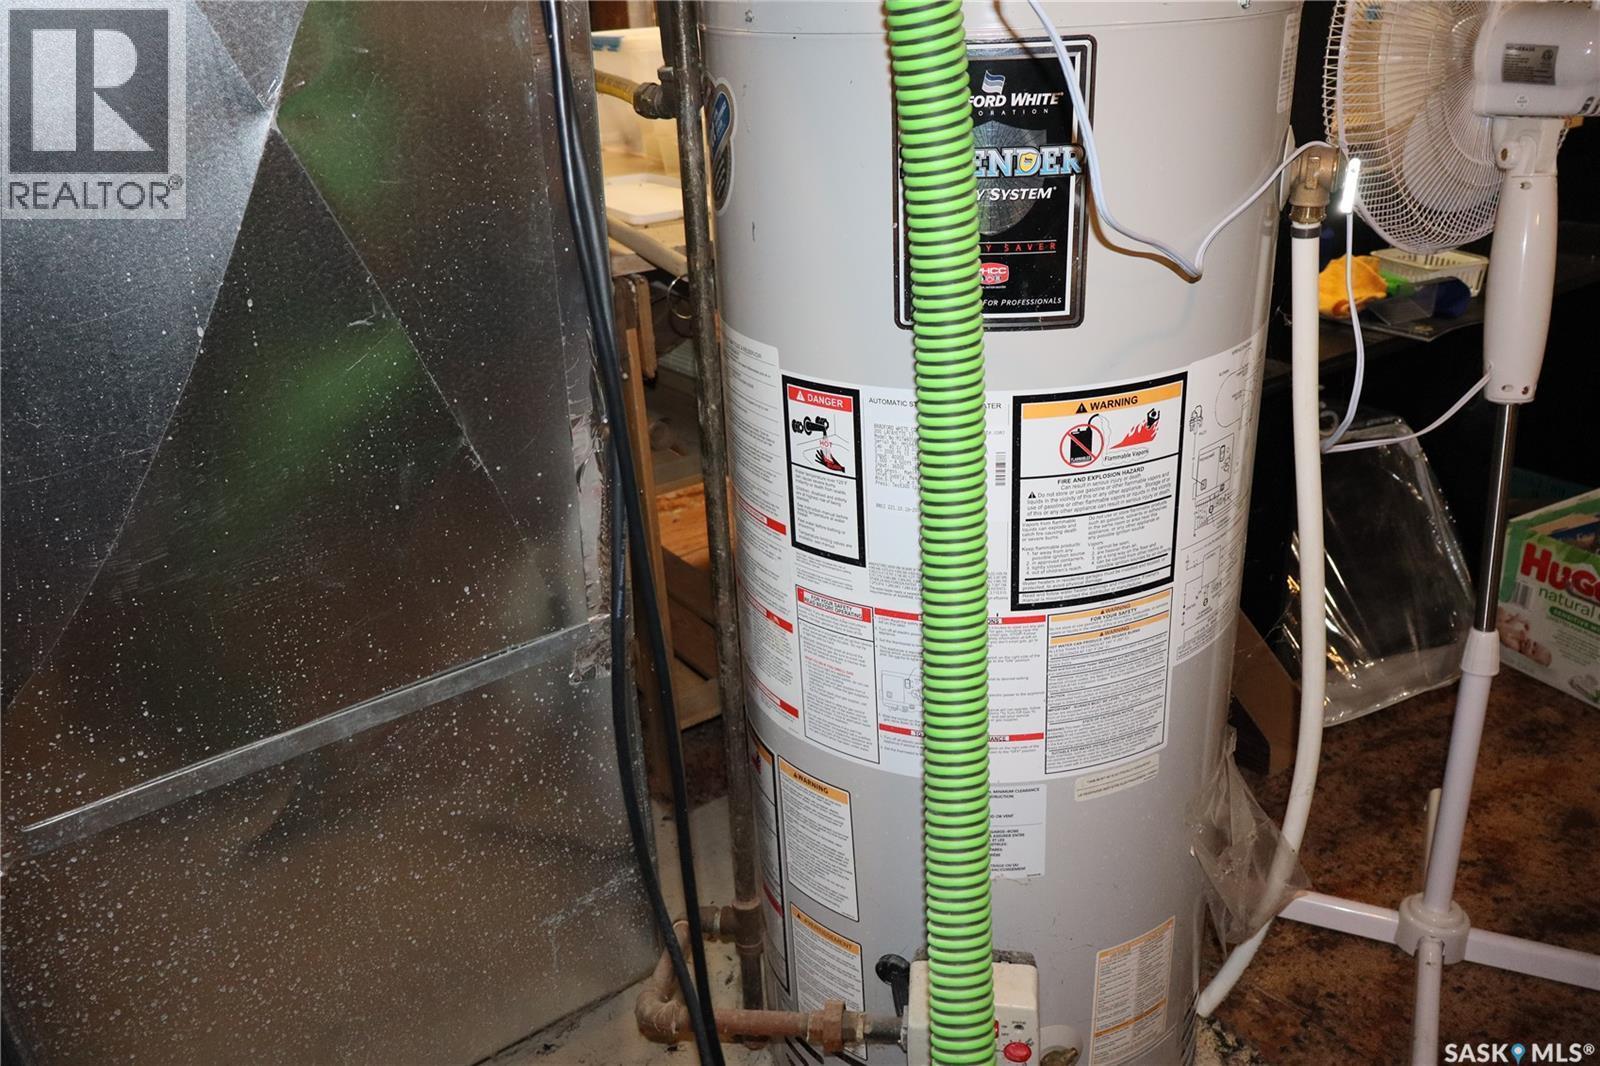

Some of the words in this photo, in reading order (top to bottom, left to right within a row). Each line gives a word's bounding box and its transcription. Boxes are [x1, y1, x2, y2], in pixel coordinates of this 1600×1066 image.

[969, 94, 1007, 108] FORD
[1011, 92, 1060, 106] WHITE
[974, 146, 1083, 178] ENDER
[990, 187, 1052, 200] SYSTEM
[1004, 242, 1056, 252] SAVER
[1001, 297, 1062, 306] PROFESSIONALS
[807, 394, 843, 408] DANGER
[869, 397, 908, 407] AUTOMATIC
[1090, 396, 1138, 410] WARNING
[1104, 452, 1132, 461] Flammable
[1132, 449, 1149, 457] Vapors
[1088, 472, 1120, 481] EXPLOSION
[1122, 466, 1144, 475] HAZARD
[1521, 542, 1600, 602] HUG
[817, 601, 834, 610] BEFORE
[834, 601, 852, 611] SAFETY
[1105, 604, 1130, 613] WARNING
[1539, 587, 1596, 618] natural
[1119, 608, 1137, 616] SAFETY
[1105, 626, 1129, 635] WARNING
[799, 774, 828, 794] WARNING
